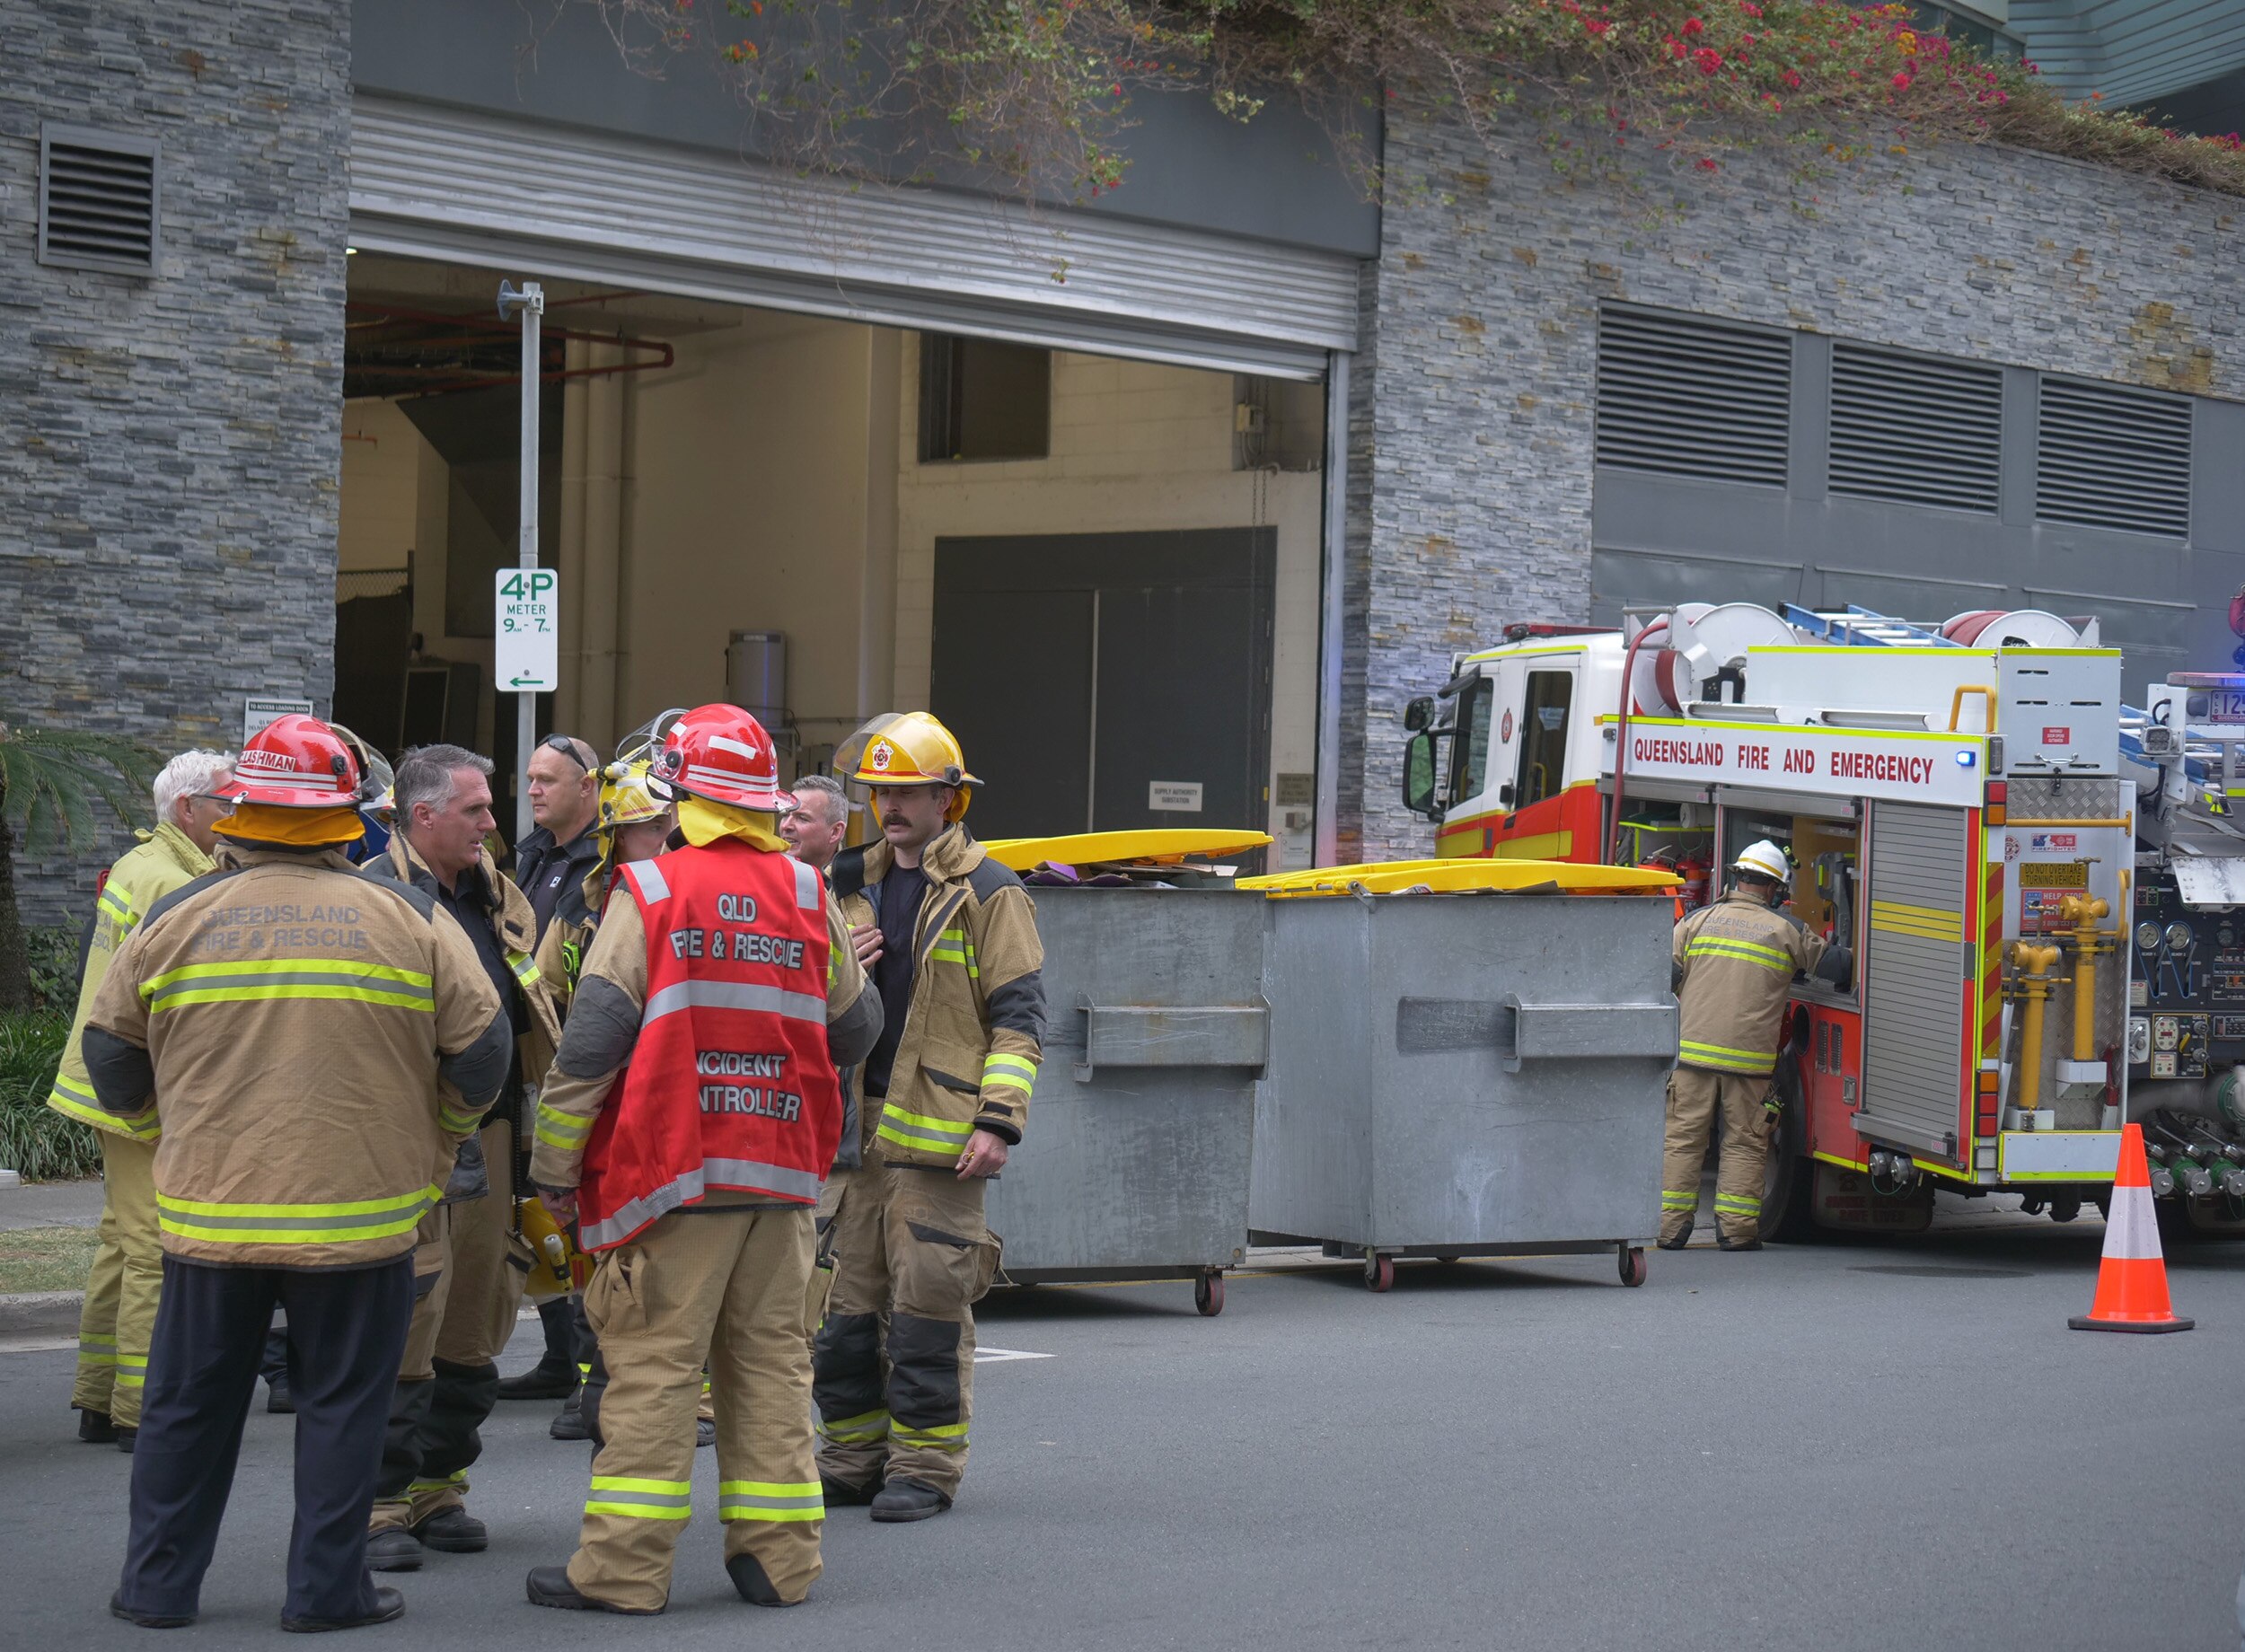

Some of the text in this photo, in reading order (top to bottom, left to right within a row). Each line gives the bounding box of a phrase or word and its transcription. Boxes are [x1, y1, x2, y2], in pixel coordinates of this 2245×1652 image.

[500, 573, 553, 601] 4P
[506, 604, 546, 614] METER
[275, 704, 295, 712] LOADING
[295, 705, 309, 713] DOCK
[1634, 738, 1933, 784] QUEENSLAND FIRE AND EMERGENCY
[1154, 787, 1197, 796] SUPPLY AUTHORITY
[1161, 796, 1190, 804] SUBSTATION
[2025, 864, 2082, 874] DO NOT OVERTAKE
[2025, 874, 2081, 885] TURNING VEHICLE
[2043, 892, 2062, 900] HELP
[202, 904, 361, 929] QUEENSLAND
[718, 893, 757, 923] QLD
[1700, 925, 1721, 935] FIRE
[1724, 927, 1731, 936] &
[1705, 916, 1774, 933] QUEENSLAND
[193, 927, 369, 953] FIRE & RESCUE
[711, 930, 726, 959] &
[734, 932, 805, 970] RESCUE
[697, 1050, 787, 1078] NCIDENT
[699, 1085, 802, 1122] NTROLLER
